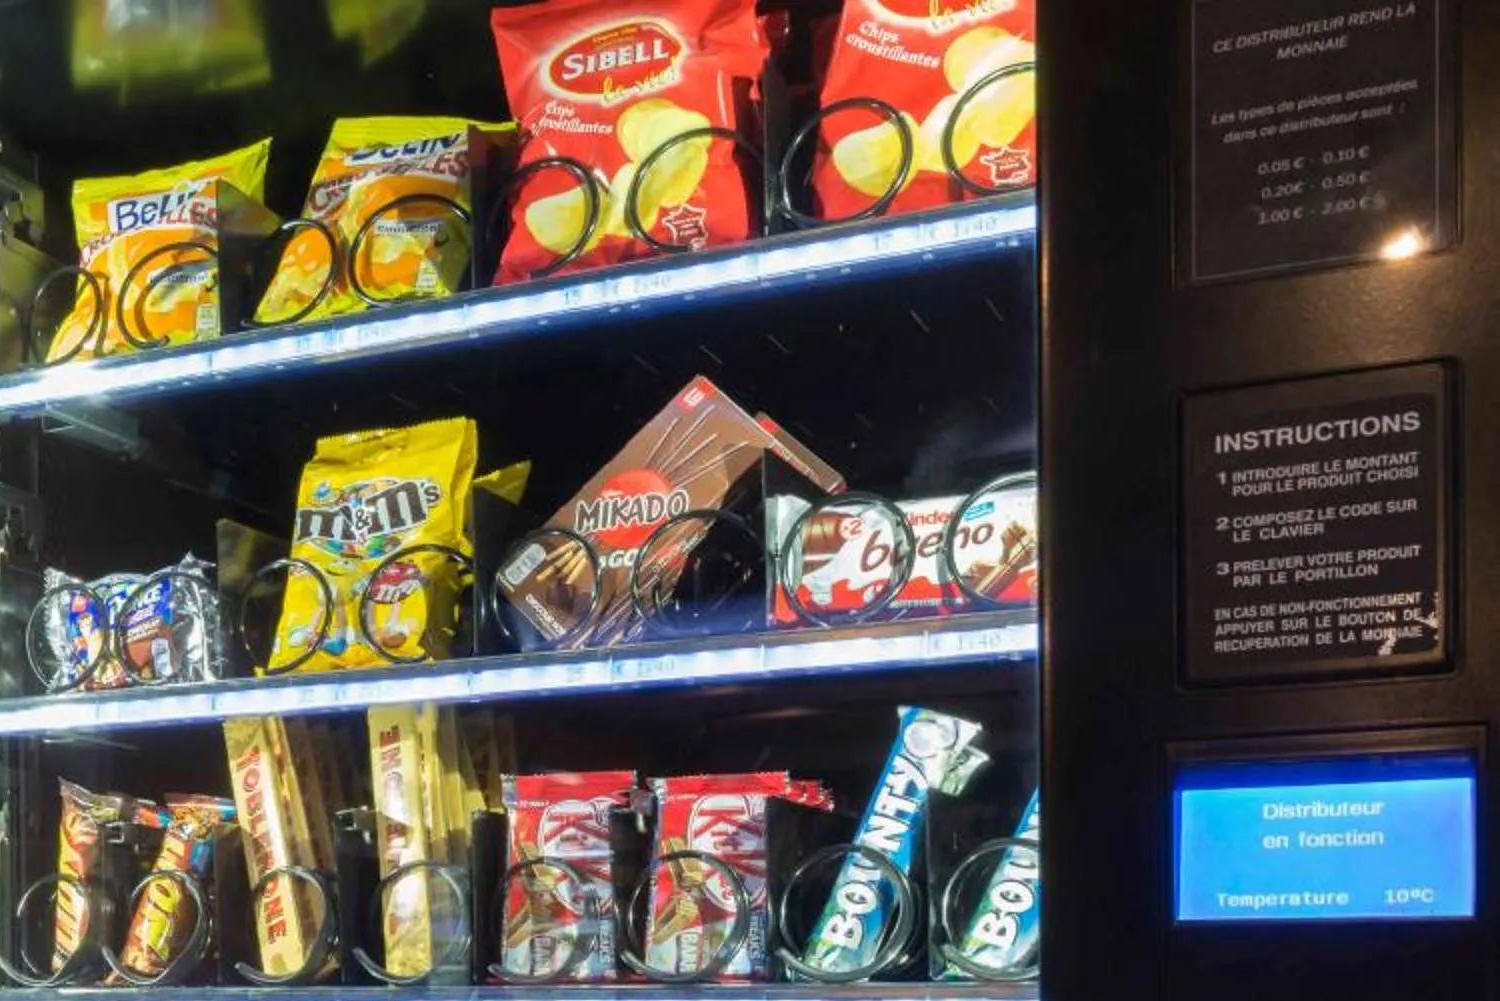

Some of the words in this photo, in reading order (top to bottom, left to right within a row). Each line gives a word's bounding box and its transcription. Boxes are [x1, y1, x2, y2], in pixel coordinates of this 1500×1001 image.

[858, 19, 901, 44] Chips
[1213, 40, 1231, 53] CE
[1236, 16, 1344, 50] DISTRIBUTEUR
[1348, 7, 1393, 26] REND
[1396, 3, 1416, 18] LA
[561, 38, 669, 81] SIBELL
[845, 33, 941, 70] croustillantes
[1277, 36, 1348, 60] MONNAIE
[1214, 411, 1421, 454] INSTRUCTIONS
[1218, 472, 1226, 485] 1
[1232, 464, 1319, 484] INTRODUIRE
[1323, 460, 1341, 473] LE
[1346, 451, 1418, 470] MONTANT
[1232, 481, 1273, 497] POUR
[1277, 478, 1293, 492] LE
[1298, 472, 1364, 490] PRODUIT
[1367, 466, 1418, 483] CHOISI
[573, 488, 689, 535] MIKADO
[1216, 517, 1230, 530] 2
[1233, 510, 1314, 529] COMPOSEZ
[1318, 508, 1336, 521] LE
[1339, 503, 1381, 518] CODE
[1386, 499, 1417, 513] SUR
[860, 523, 995, 573] bueno
[1233, 530, 1250, 543] LE
[1260, 523, 1325, 540] CLAVIER
[1217, 562, 1230, 575] 3
[1233, 554, 1303, 574] PRELEVER
[1307, 551, 1353, 566] VOTRE
[1358, 545, 1422, 562] PRODUIT
[1233, 574, 1261, 587] PAR
[1269, 572, 1287, 584] LE
[1295, 565, 1379, 583] PORTILLON
[1214, 608, 1230, 620] EN
[1233, 606, 1257, 619] CAS
[1260, 604, 1276, 617] DE
[1215, 619, 1274, 636] APPUYER
[1281, 618, 1308, 630] SUR
[1315, 616, 1331, 627] LE
[1338, 610, 1396, 626] BOUTON
[1403, 608, 1422, 621] DE
[1214, 634, 1309, 652] RECUPERATION
[1315, 633, 1333, 644] DE
[1339, 630, 1357, 642] LA
[1263, 801, 1385, 820] Distributeur
[820, 753, 928, 951] BOUNTY
[1263, 834, 1288, 849] en
[1299, 830, 1384, 848] fonction
[1217, 892, 1348, 910] Temperature
